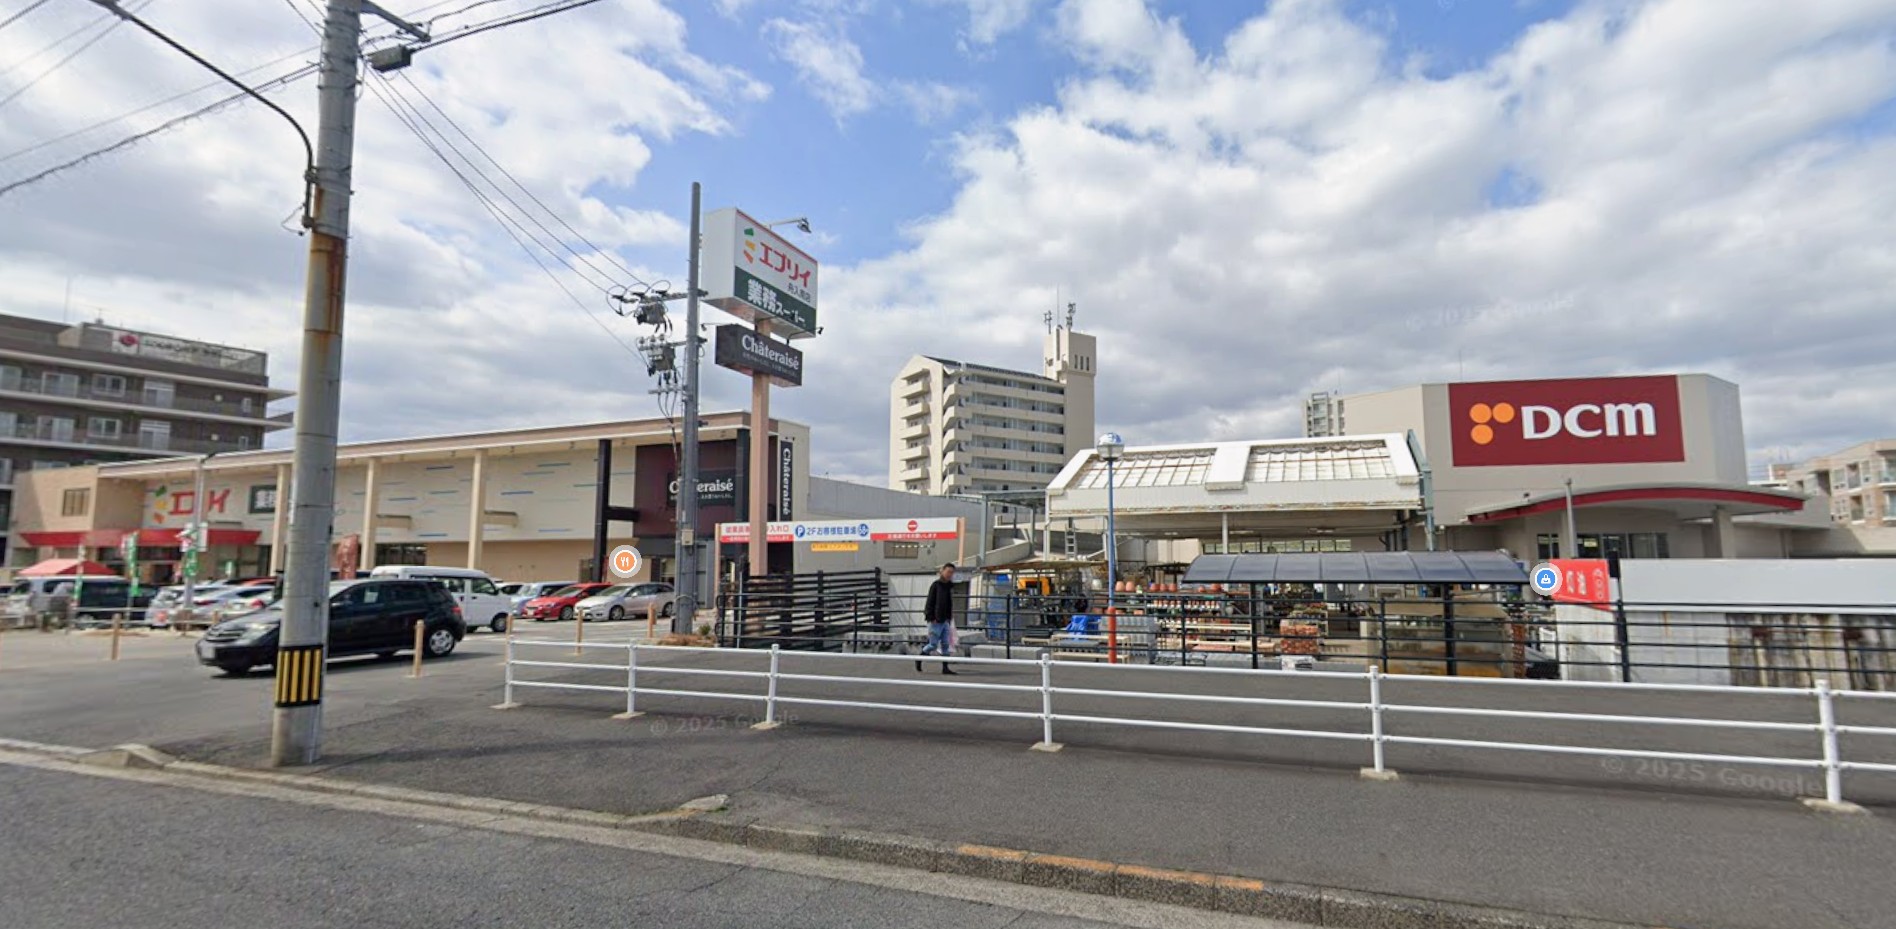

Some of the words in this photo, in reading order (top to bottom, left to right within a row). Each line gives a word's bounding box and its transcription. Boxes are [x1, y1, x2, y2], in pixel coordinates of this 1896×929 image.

[742, 334, 799, 370] Châteraisé
[1520, 402, 1656, 439] DCM
[669, 477, 734, 494] Ceraisé
